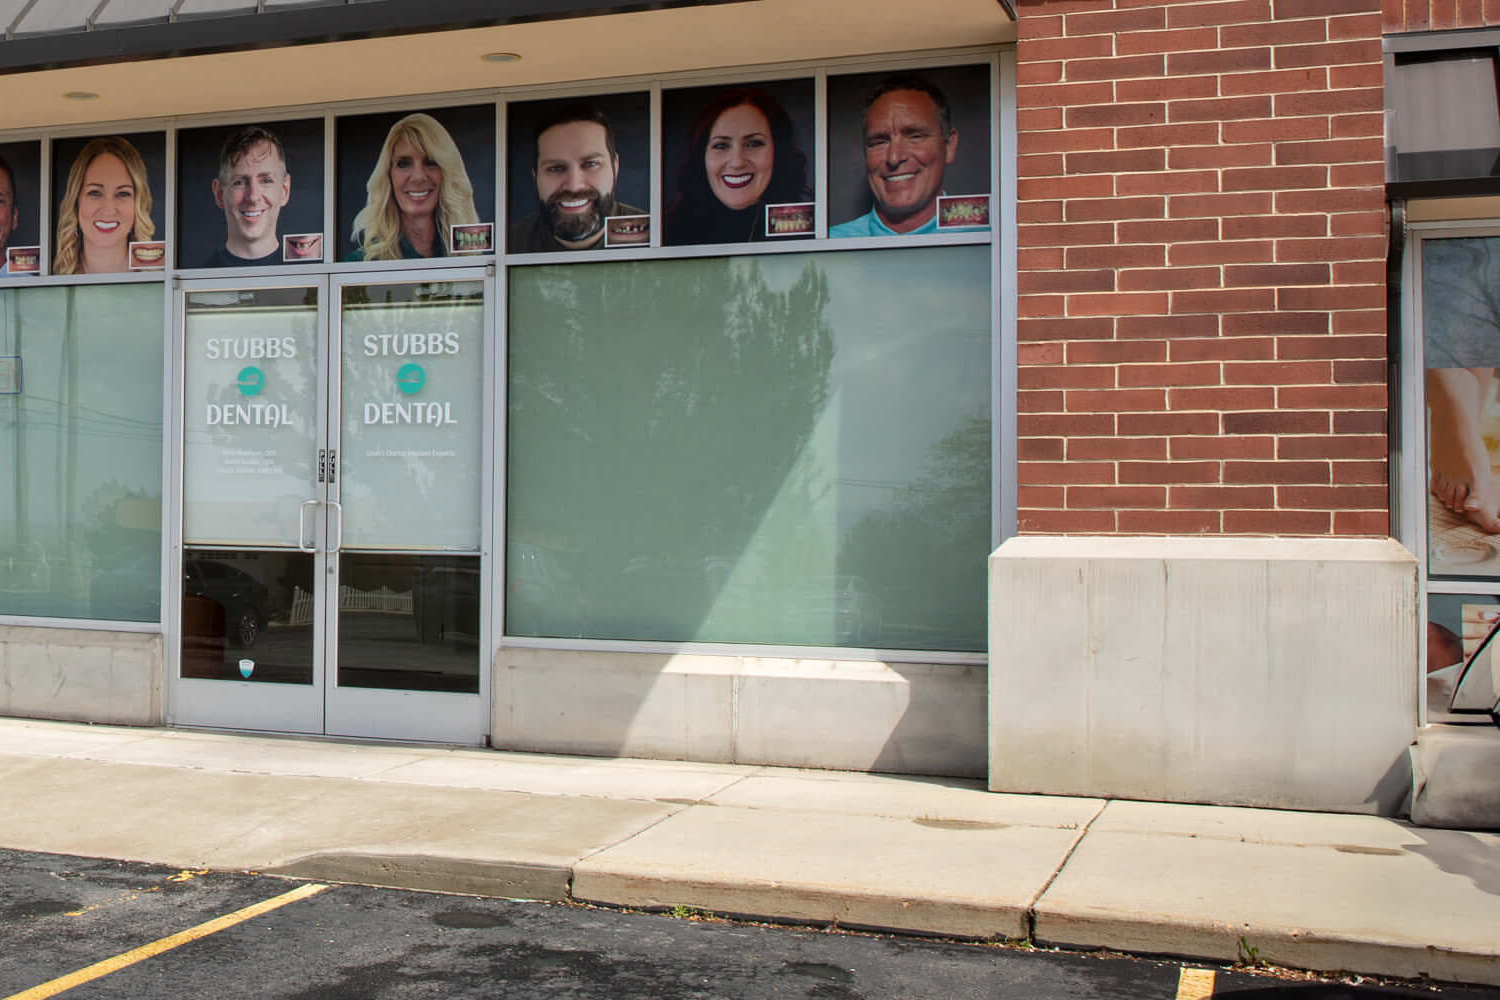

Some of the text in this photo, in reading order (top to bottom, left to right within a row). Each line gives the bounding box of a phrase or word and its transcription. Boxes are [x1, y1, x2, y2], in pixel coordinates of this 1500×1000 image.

[207, 337, 296, 359] STUBBS
[364, 332, 460, 356] STUBBS
[207, 404, 294, 428] DENTAL
[364, 402, 458, 427] DENTAL
